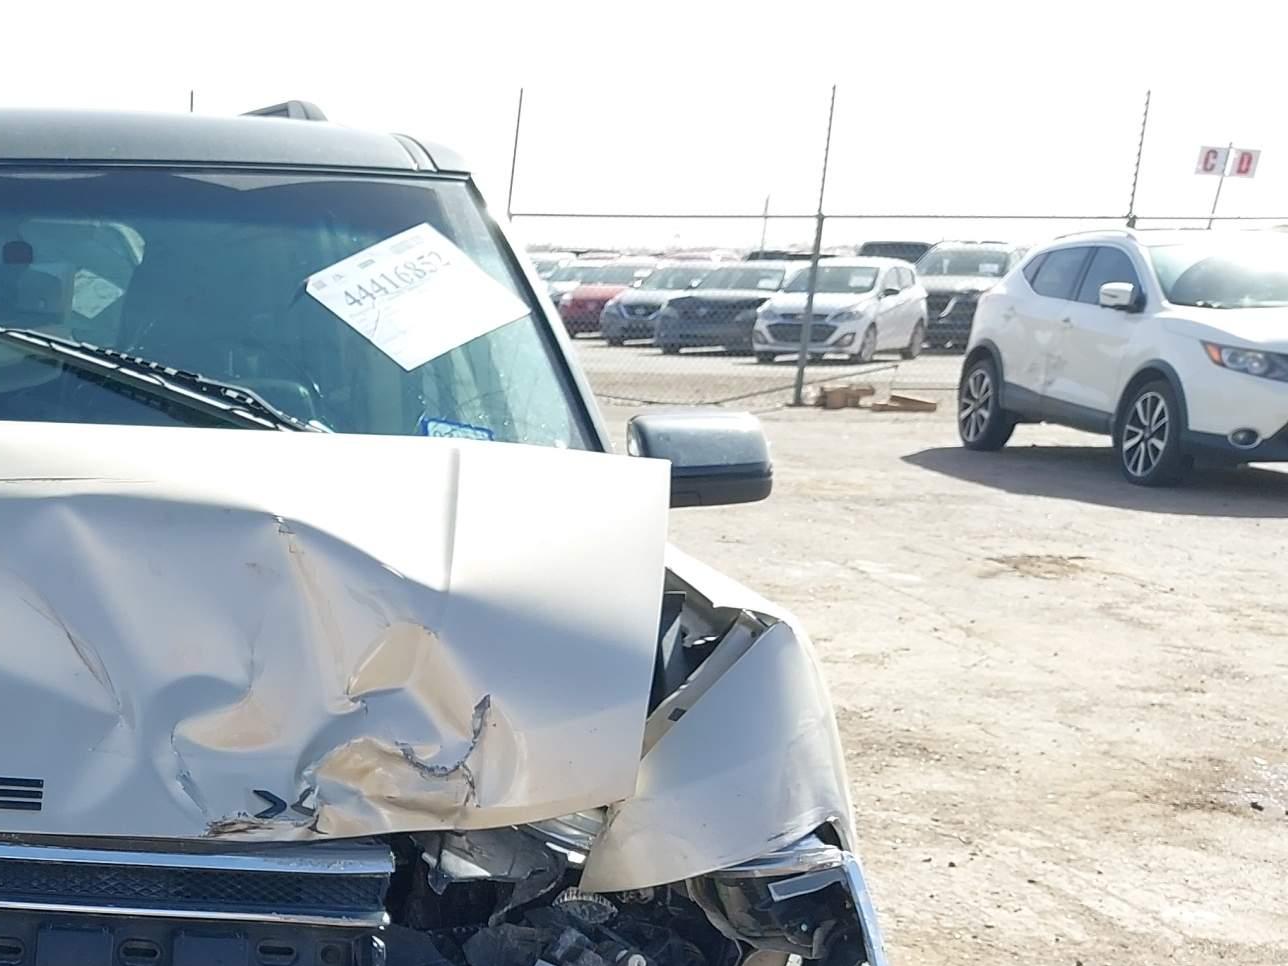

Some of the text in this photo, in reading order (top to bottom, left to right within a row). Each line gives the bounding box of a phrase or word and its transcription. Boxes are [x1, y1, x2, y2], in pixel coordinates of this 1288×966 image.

[1202, 149, 1218, 172] C
[1236, 151, 1253, 174] D
[343, 250, 451, 308] 44416852
